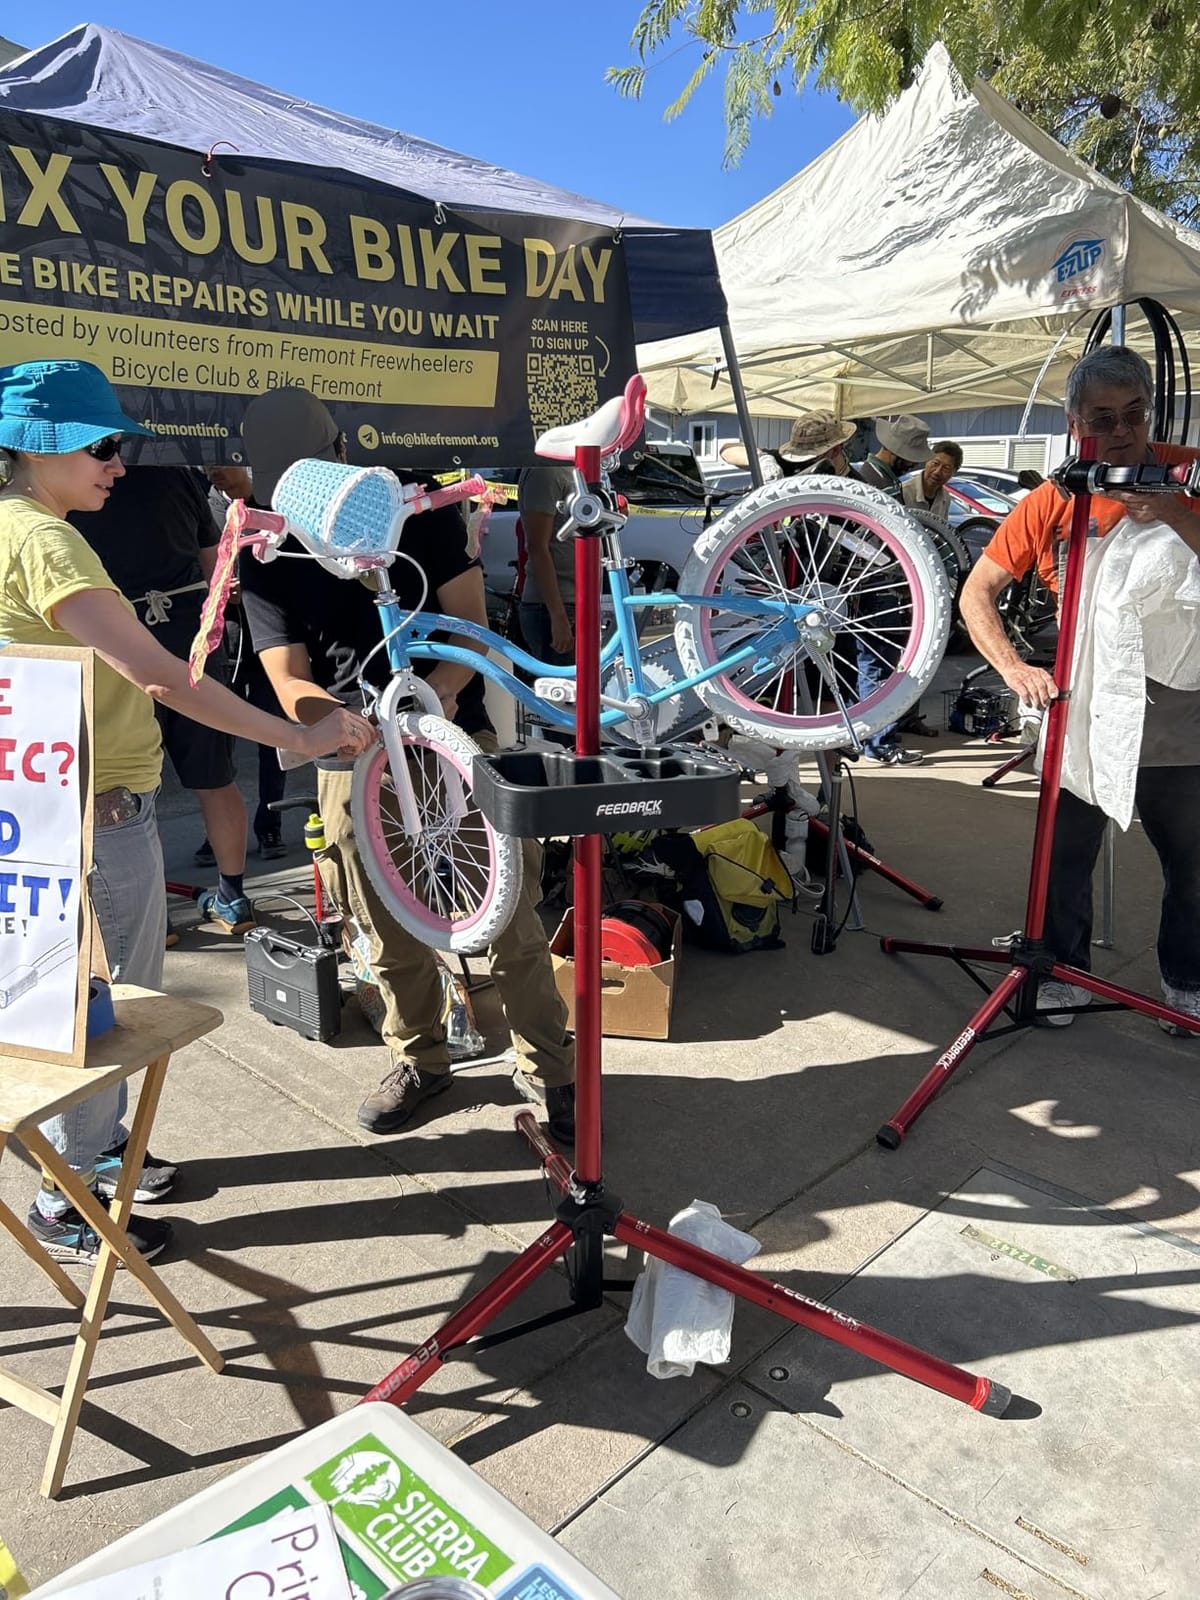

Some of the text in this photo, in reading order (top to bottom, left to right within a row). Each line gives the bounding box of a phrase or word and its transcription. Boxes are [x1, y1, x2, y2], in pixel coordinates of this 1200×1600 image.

[0, 145, 612, 304] X YOUR BIKE DAY
[32, 257, 119, 298] BIKE
[128, 271, 268, 317] REPAIRS
[276, 291, 365, 330] WHILE
[372, 304, 423, 336] YOU
[430, 312, 500, 340] WAIT
[73, 316, 100, 346] by
[107, 324, 220, 354] volunteers
[227, 334, 273, 359] from
[280, 340, 356, 367] Fremont
[360, 349, 474, 375] Freewheelers
[530, 336, 589, 351] TO SIGN UP
[531, 317, 588, 334] SCAN HERE
[112, 356, 382, 398] Bicycle Club & Bike Fremont
[381, 431, 500, 448] info@bikefremont.org
[596, 799, 663, 816] FEEDBACK
[936, 1026, 975, 1070] FEEDBACK
[366, 1512, 437, 1578] CLUB
[393, 1490, 490, 1582] SIERRA
